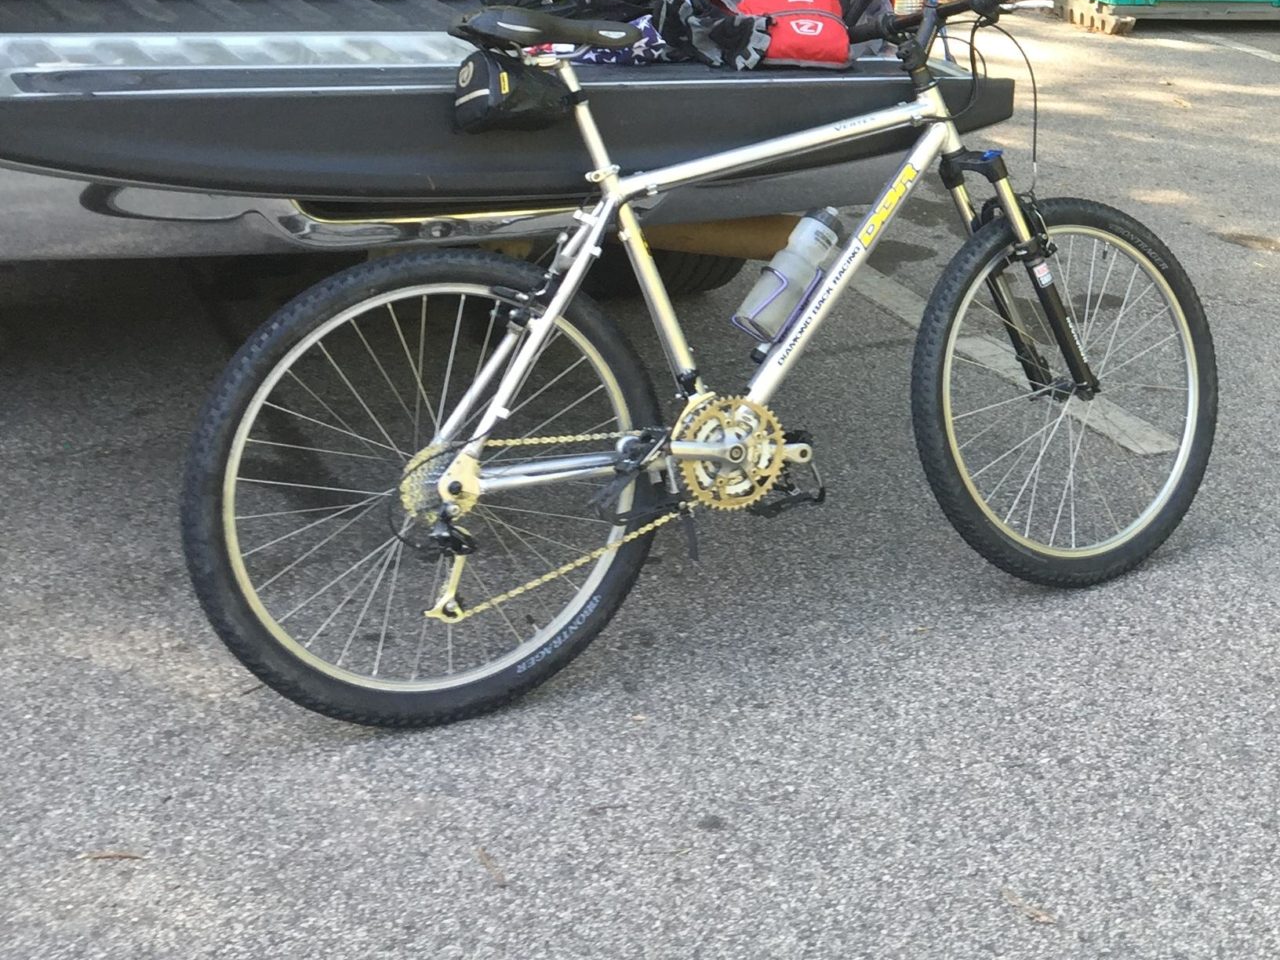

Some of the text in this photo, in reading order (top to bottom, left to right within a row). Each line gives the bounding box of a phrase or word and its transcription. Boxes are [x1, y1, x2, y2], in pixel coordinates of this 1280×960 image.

[857, 163, 919, 251] DBR
[777, 246, 861, 366] DIAMOND BACK RACING
[516, 600, 598, 674] BONTRAGER
